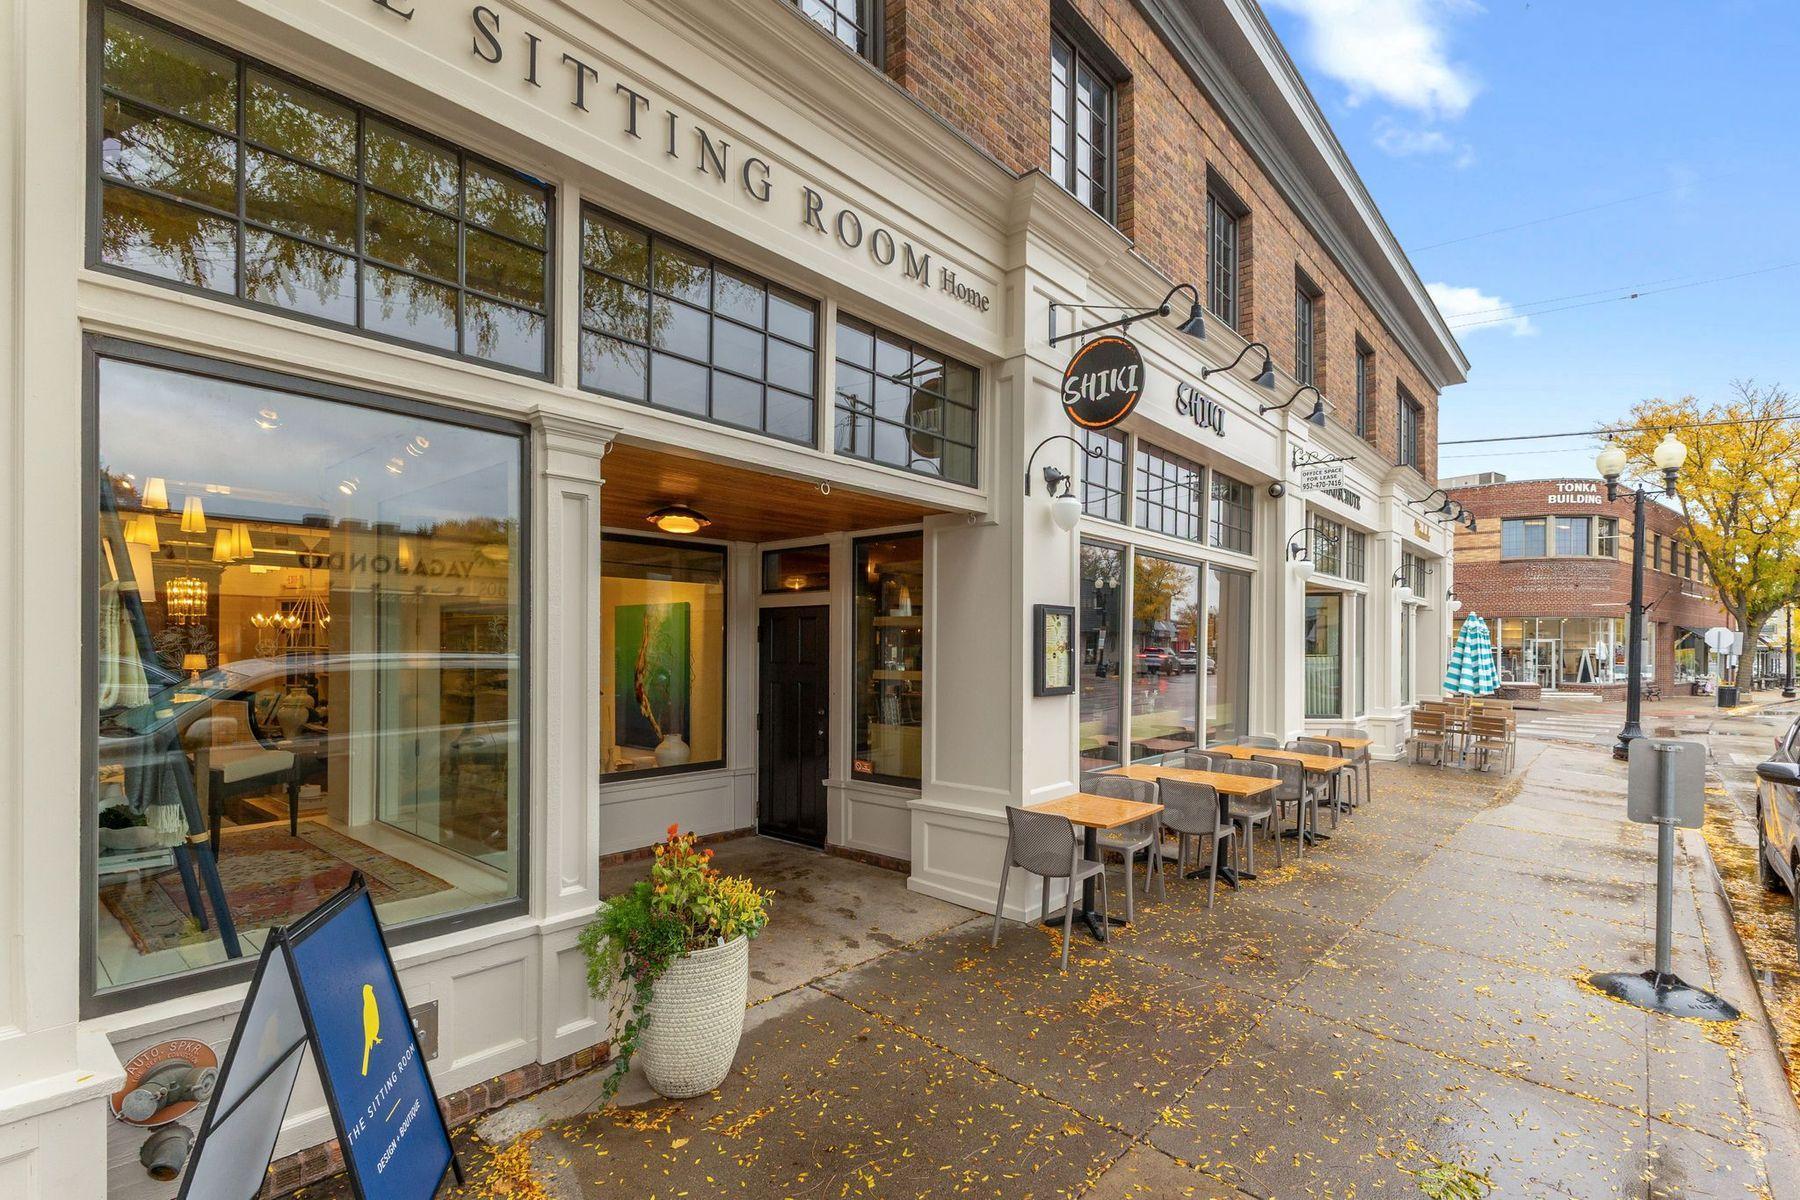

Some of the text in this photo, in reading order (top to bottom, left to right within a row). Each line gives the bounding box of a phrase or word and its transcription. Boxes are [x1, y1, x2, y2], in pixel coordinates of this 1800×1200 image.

[471, 5, 990, 312] SITTING ROOM Home
[1063, 364, 1139, 405] SHIKI
[1176, 381, 1226, 437] SHIKI
[1547, 494, 1602, 504] BUILDING
[1556, 482, 1597, 492] TONKA
[347, 1117, 366, 1146] THE
[367, 1071, 397, 1118] SITTING
[377, 1139, 397, 1174] DESIGN
[399, 1098, 421, 1138] BOUTIQUE
